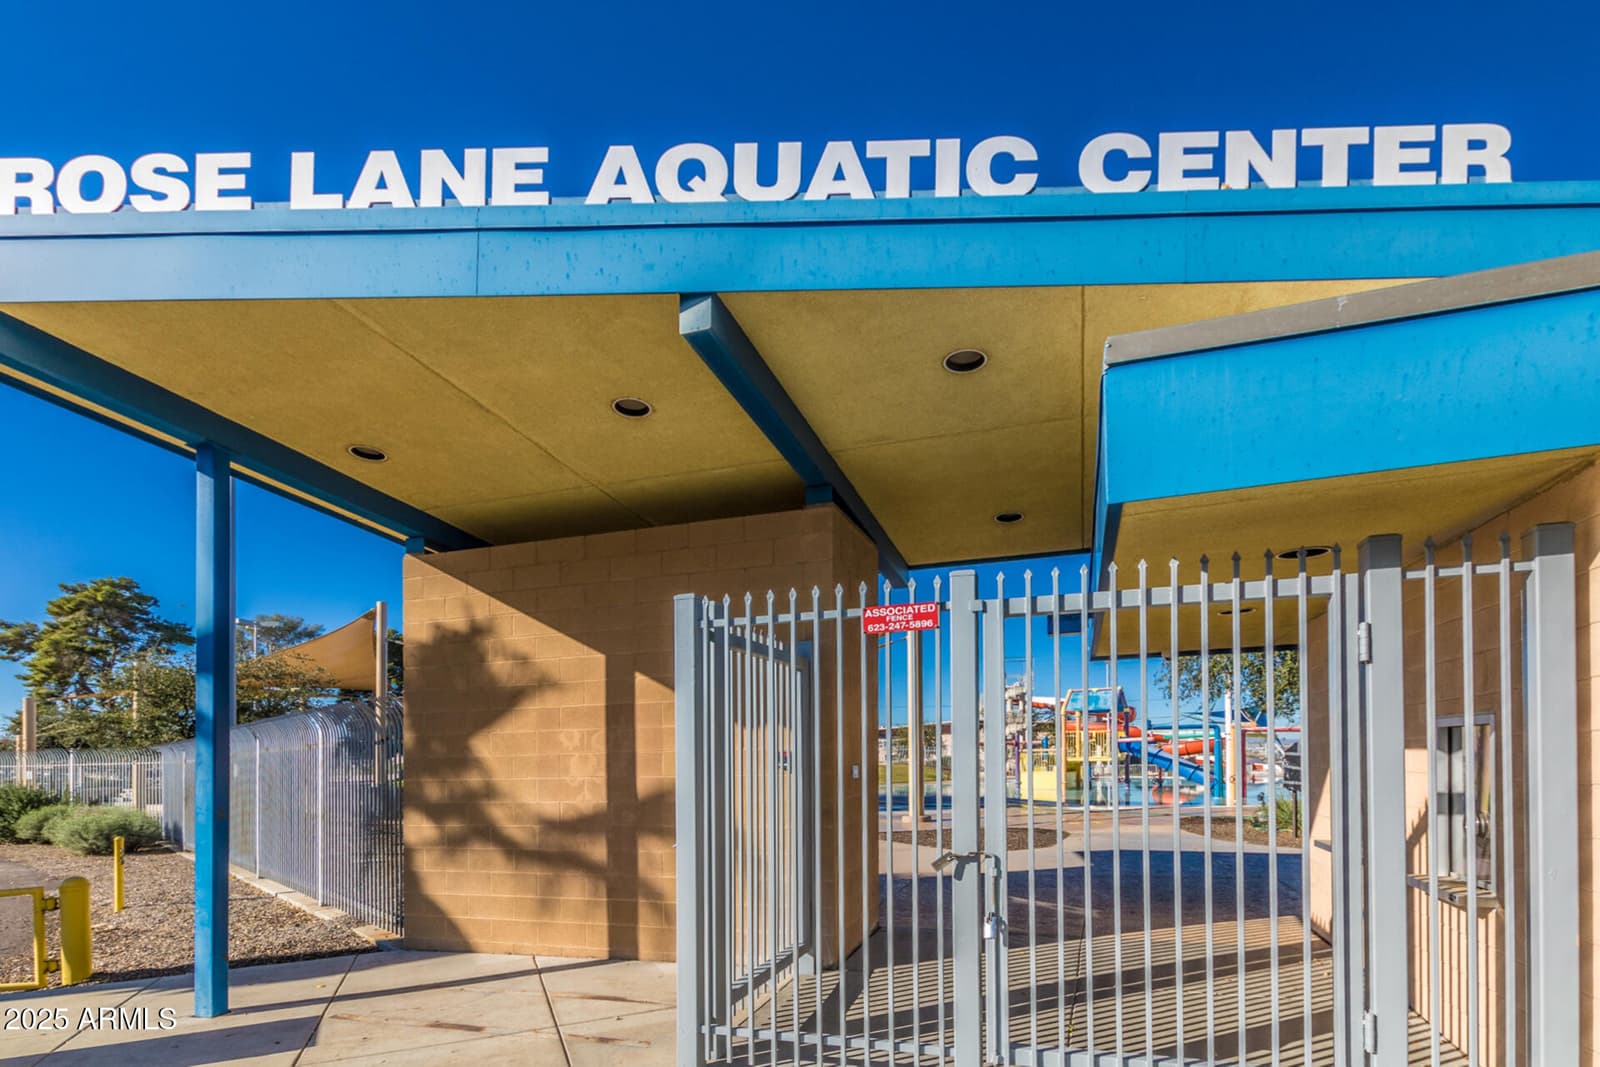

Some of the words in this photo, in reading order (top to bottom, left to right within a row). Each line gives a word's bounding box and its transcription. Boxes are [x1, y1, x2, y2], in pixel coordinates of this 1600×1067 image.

[0, 152, 253, 214] ROSE
[290, 147, 550, 209] LANE
[584, 135, 1039, 205] AQUATIC
[1078, 123, 1513, 193] CENTER
[865, 604, 936, 618] ASSOCIATED
[886, 614, 914, 622] FENCE
[867, 619, 934, 632] 623-247-5896
